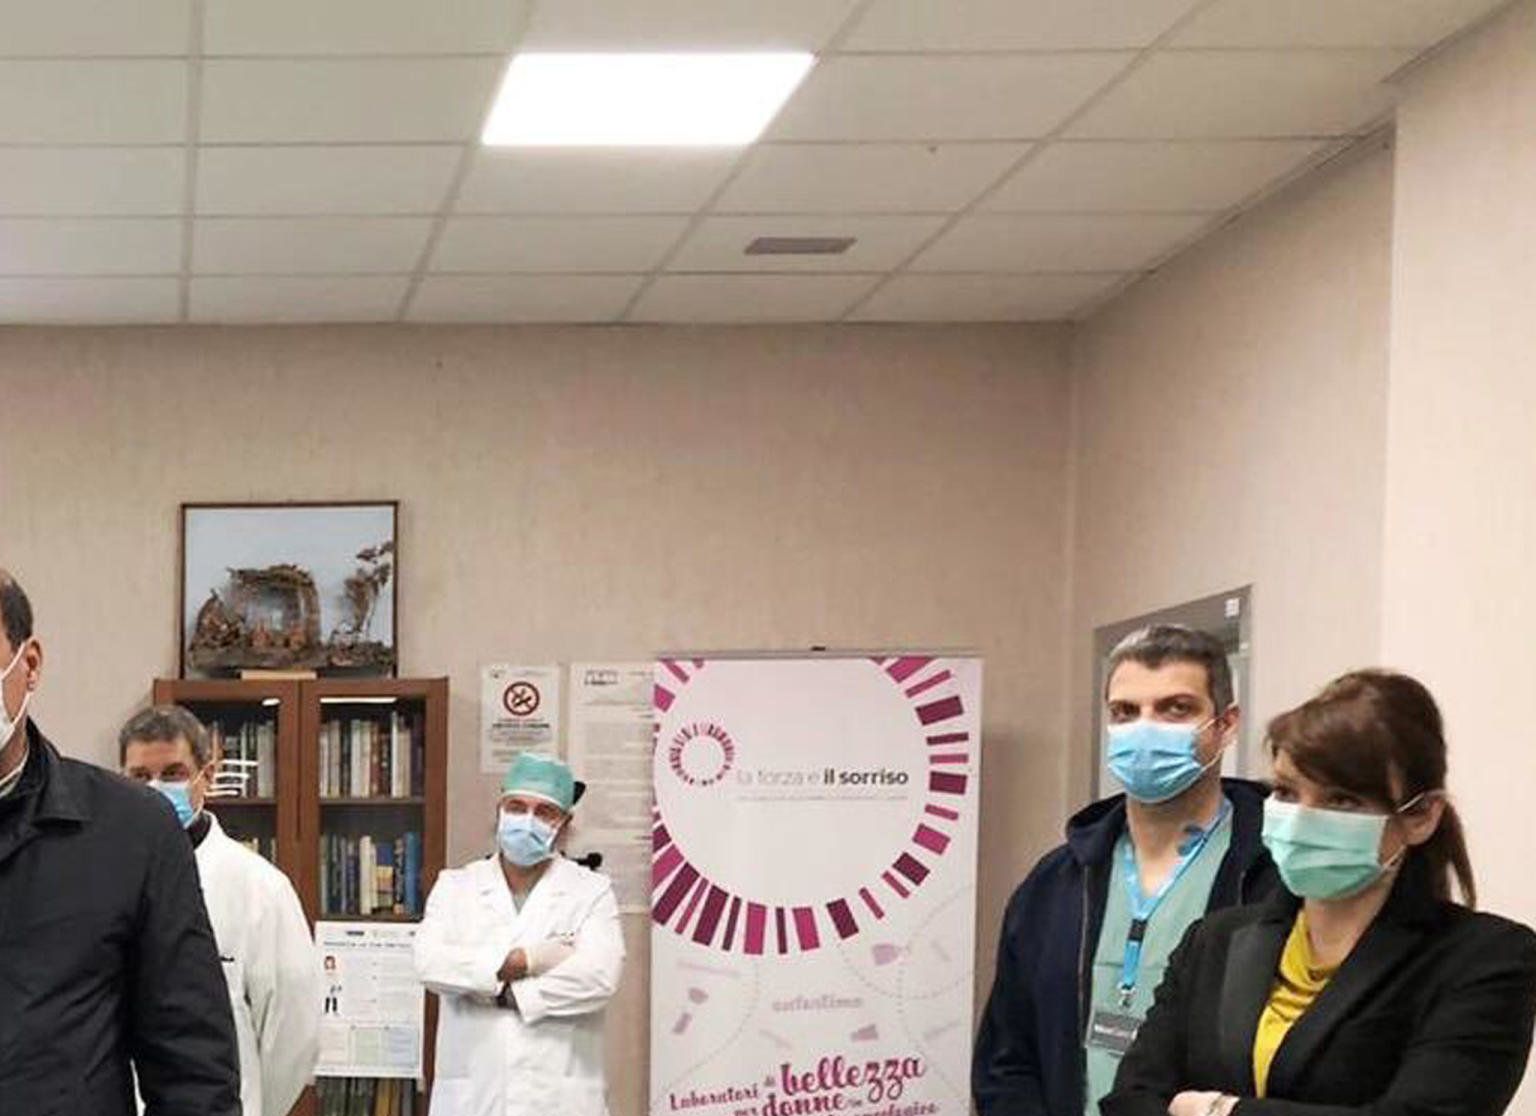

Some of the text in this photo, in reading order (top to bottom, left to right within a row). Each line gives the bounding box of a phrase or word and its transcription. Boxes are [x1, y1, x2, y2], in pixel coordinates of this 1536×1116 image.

[757, 769, 804, 785] forza
[824, 768, 835, 785] il
[839, 768, 909, 786] sorriso
[780, 1055, 926, 1103] bellezza
